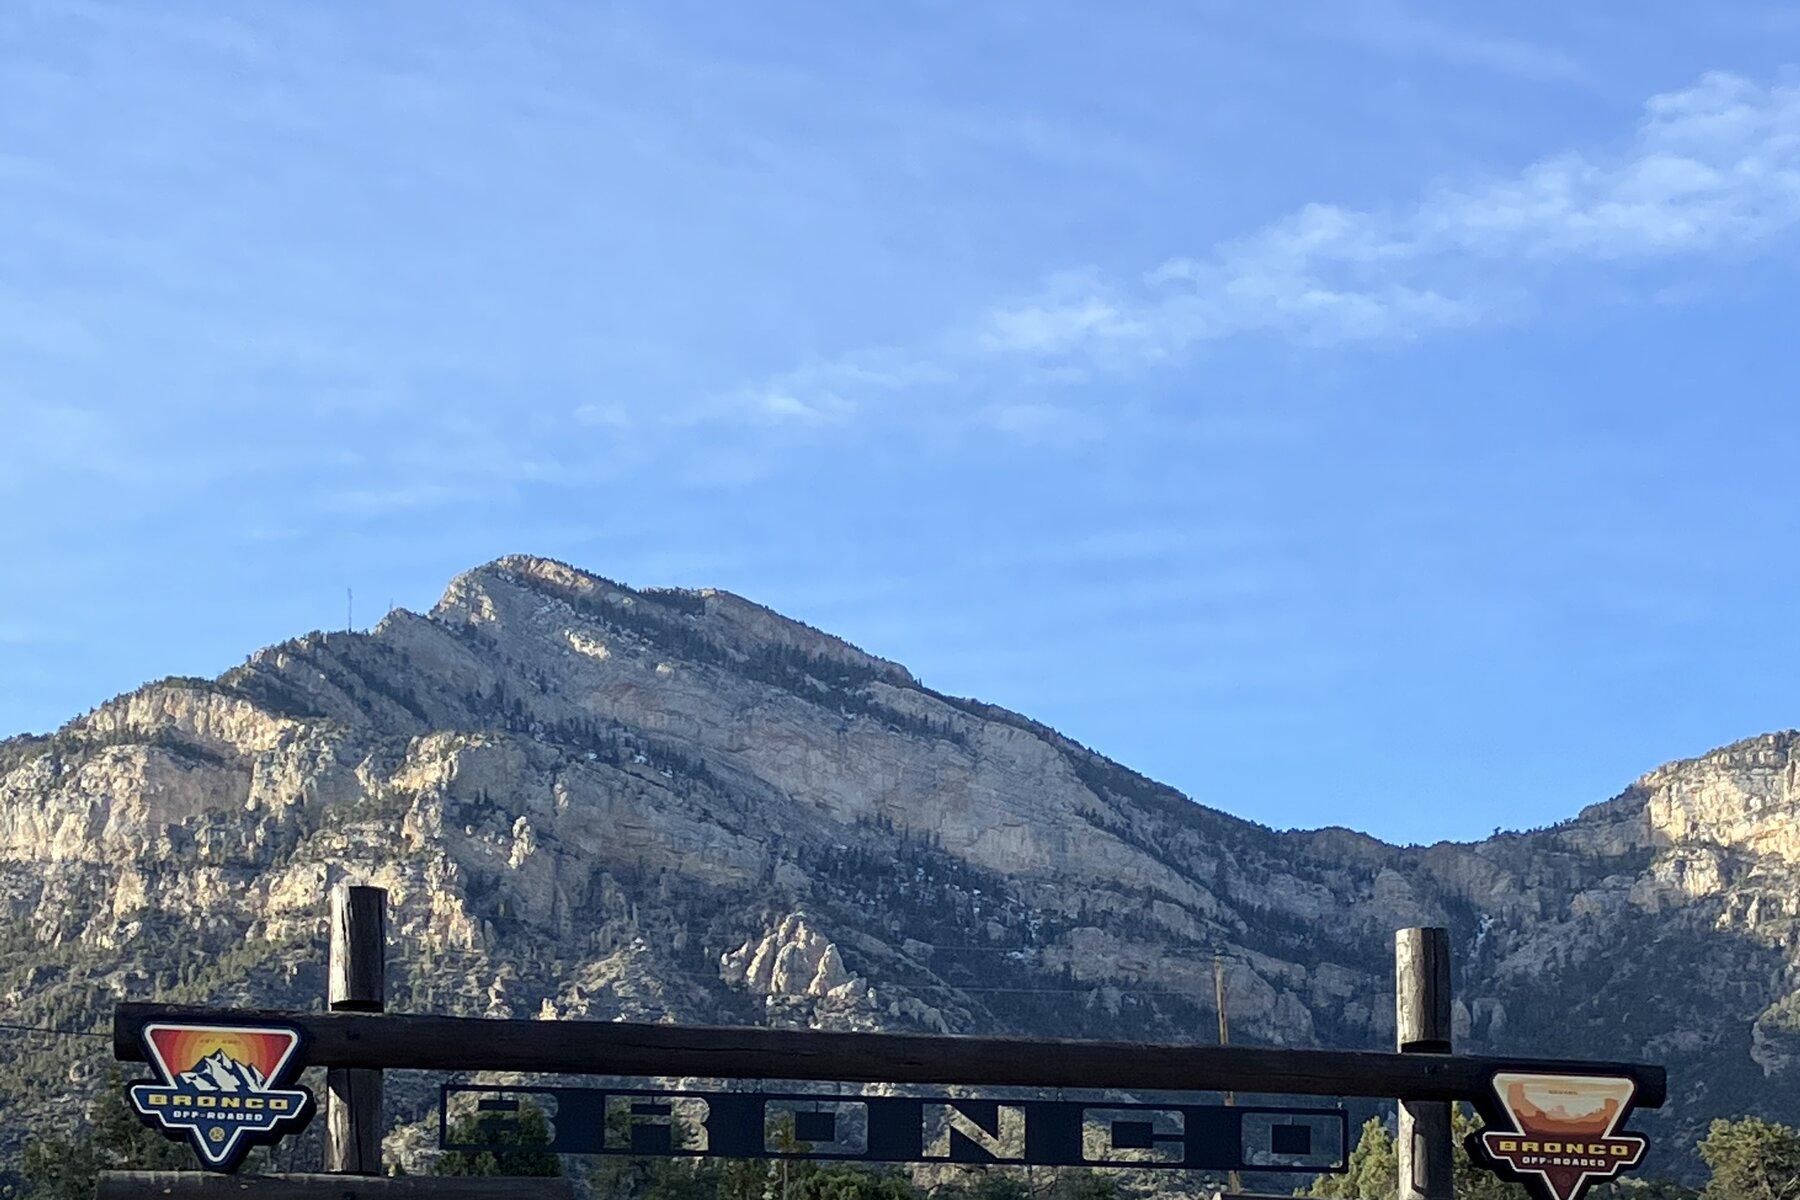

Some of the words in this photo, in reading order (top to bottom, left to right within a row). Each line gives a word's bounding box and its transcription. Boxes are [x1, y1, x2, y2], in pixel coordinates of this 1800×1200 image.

[148, 1094, 288, 1110] BRONCO
[446, 1090, 1343, 1168] BRONCO
[1500, 1141, 1628, 1156] BRONCO
